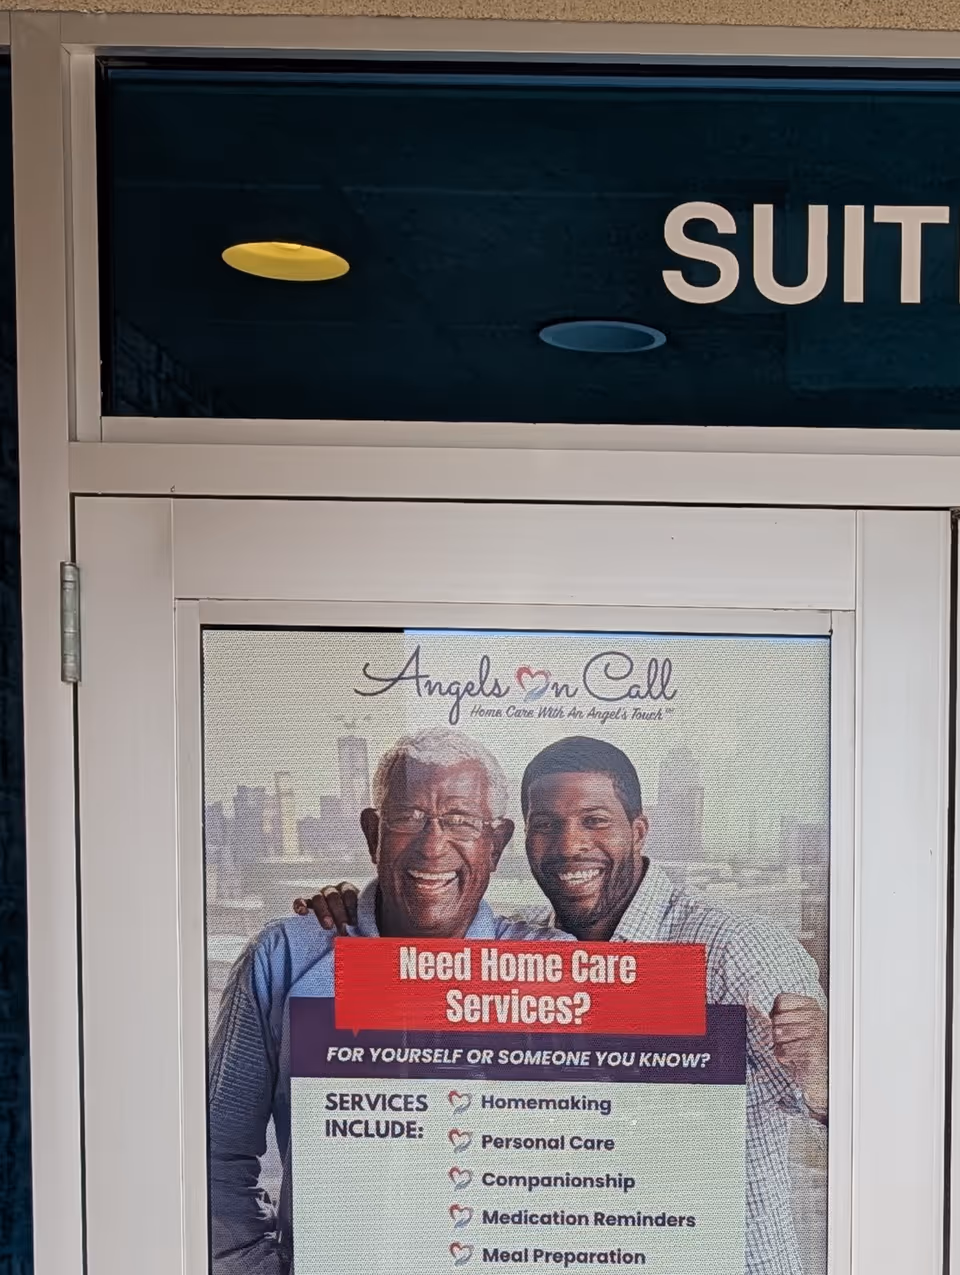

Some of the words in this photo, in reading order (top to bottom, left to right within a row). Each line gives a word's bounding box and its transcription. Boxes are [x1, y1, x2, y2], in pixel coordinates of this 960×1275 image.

[354, 645, 509, 724] Angels
[584, 651, 677, 701] Call
[470, 706, 502, 718] Home
[506, 706, 534, 718] Care
[538, 706, 565, 718] With
[567, 707, 584, 719] An
[586, 707, 627, 724] Angel's
[400, 948, 471, 981] Need
[481, 948, 562, 983] Home
[571, 950, 636, 984] Care
[446, 990, 590, 1025] Services?
[327, 1047, 364, 1062] FOR
[369, 1048, 463, 1064] YOURSELF
[466, 1049, 494, 1064] OR
[498, 1050, 592, 1066] SOMEONE
[596, 1051, 634, 1067] YOU
[639, 1052, 710, 1068] KNOW?
[325, 1093, 428, 1112] SERVICES
[481, 1095, 611, 1115] Homemaking
[325, 1119, 424, 1139] INCLUDE:
[481, 1135, 565, 1151] Personal
[569, 1135, 615, 1152] Care
[482, 1172, 635, 1192] Companionship
[482, 1210, 589, 1226] Medication
[594, 1211, 696, 1228] Reminders
[482, 1248, 528, 1264] Meal
[534, 1249, 646, 1267] Preparation
